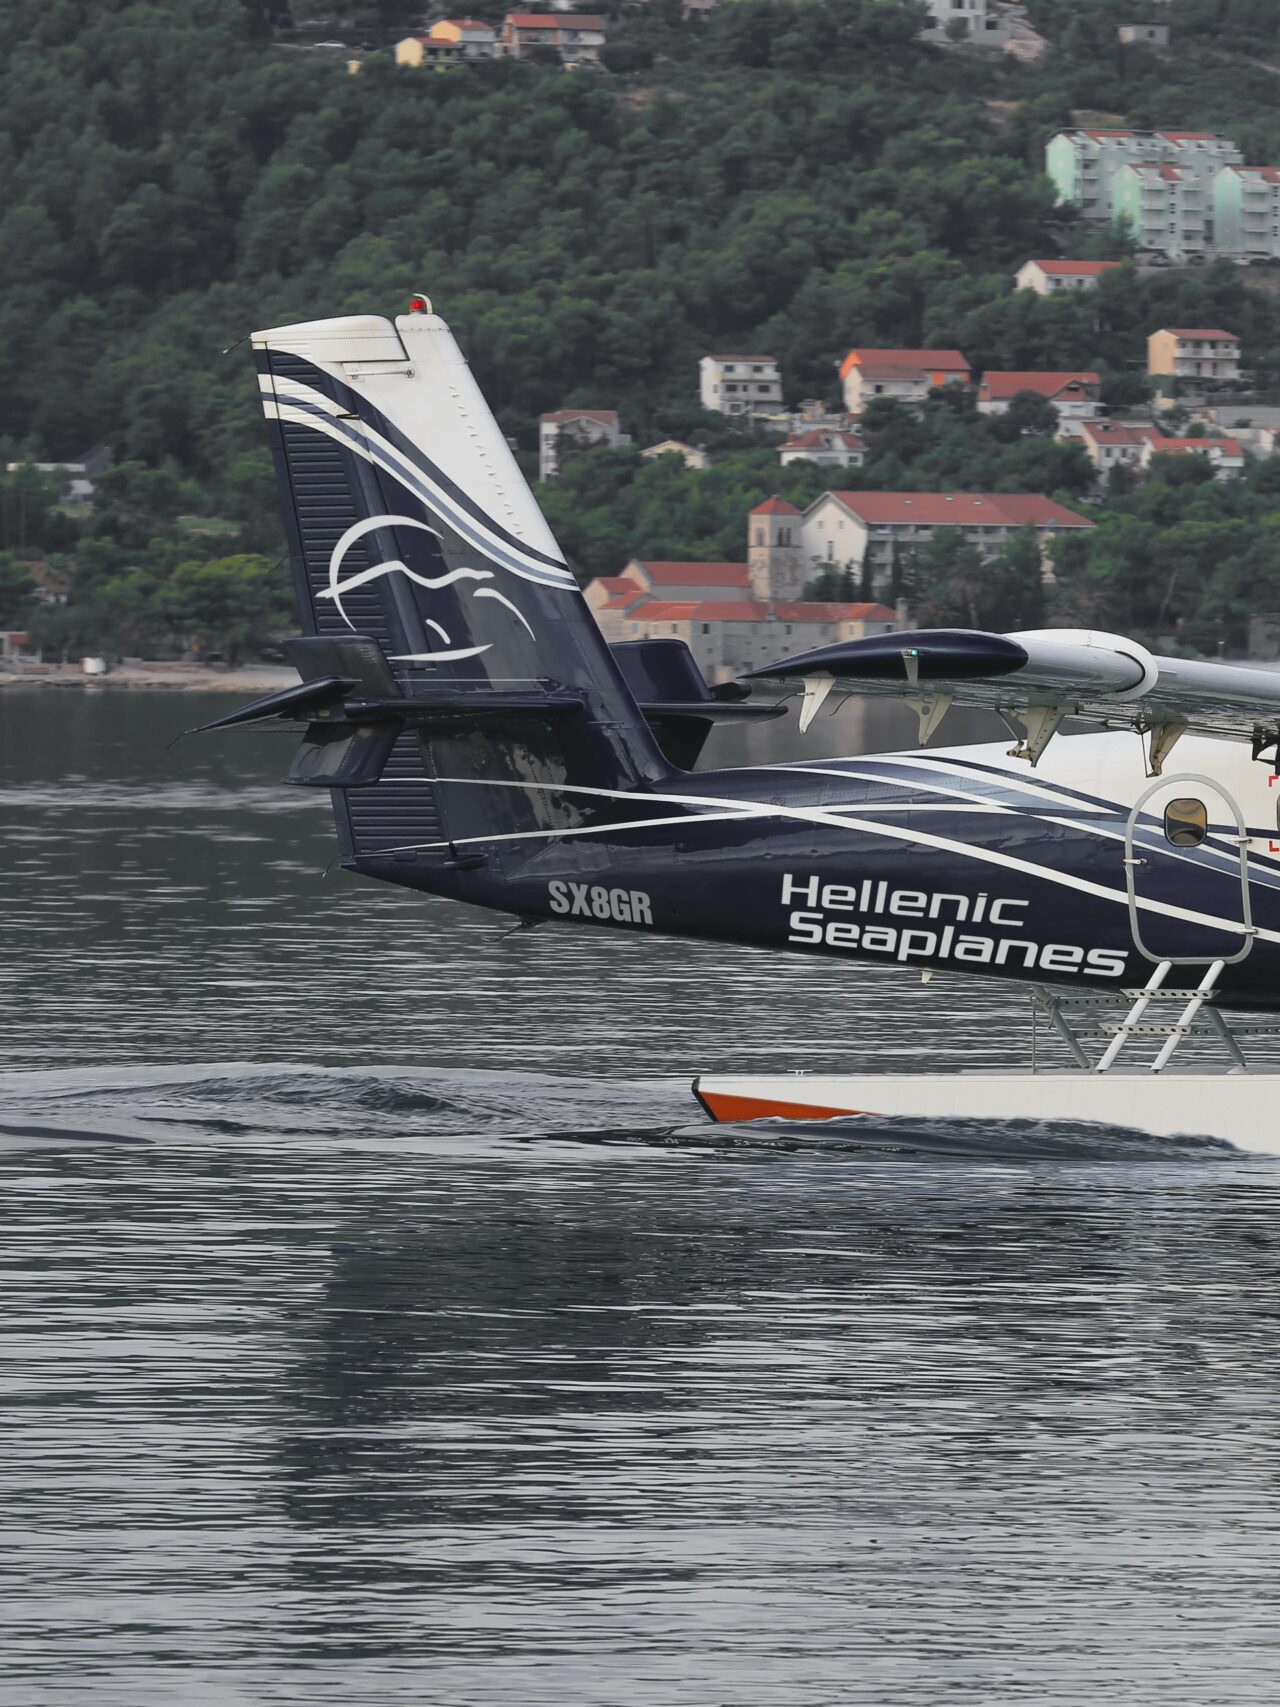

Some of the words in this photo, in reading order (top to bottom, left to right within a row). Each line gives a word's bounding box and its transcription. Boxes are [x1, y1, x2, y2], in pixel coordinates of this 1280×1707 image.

[548, 880, 653, 924] SX8GR
[781, 873, 1030, 926] Hellenic
[788, 911, 1129, 977] Seaplanes
